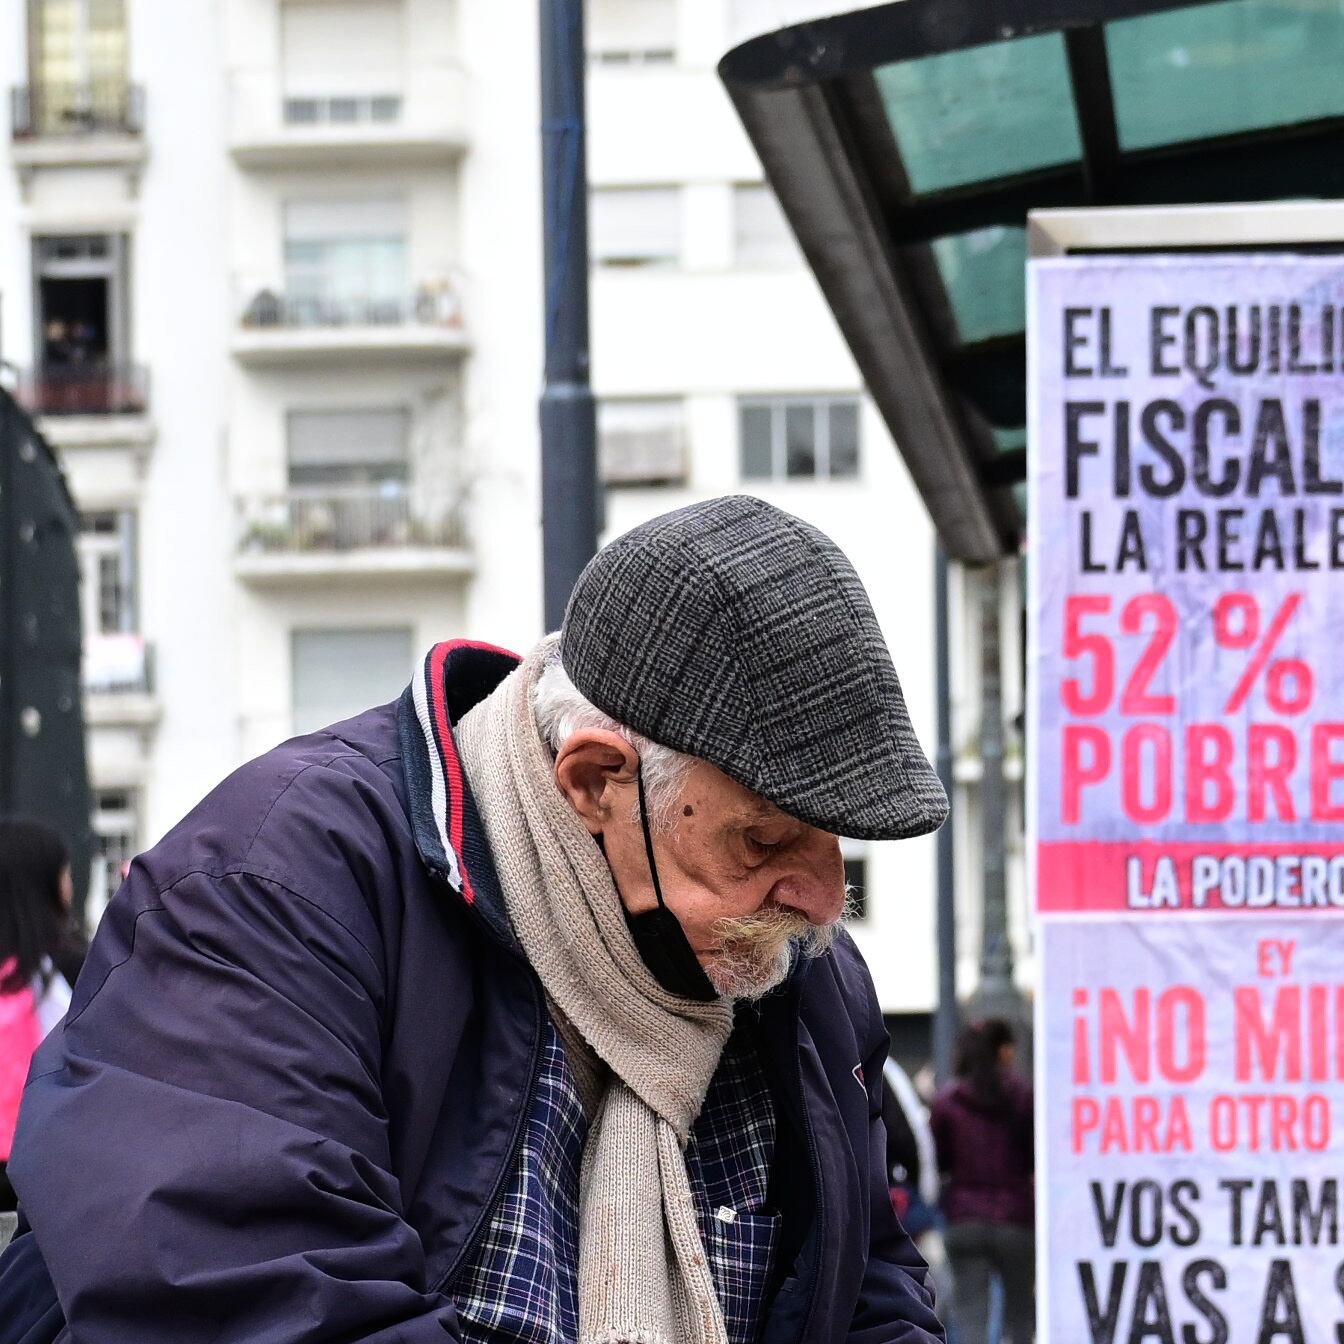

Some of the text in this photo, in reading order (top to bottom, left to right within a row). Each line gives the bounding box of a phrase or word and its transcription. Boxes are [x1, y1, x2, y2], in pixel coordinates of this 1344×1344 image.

[1065, 308, 1126, 377] EL
[1065, 398, 1343, 499] FISCAL
[1082, 510, 1147, 572] LA
[1061, 593, 1179, 719] 52
[1213, 591, 1315, 716] %
[1129, 858, 1178, 907] LA
[1259, 940, 1296, 977] EY
[1074, 985, 1207, 1085] ¡NO
[1072, 1096, 1193, 1153] PARA
[1210, 1093, 1330, 1152] OTRO
[1092, 1180, 1200, 1248] VOS
